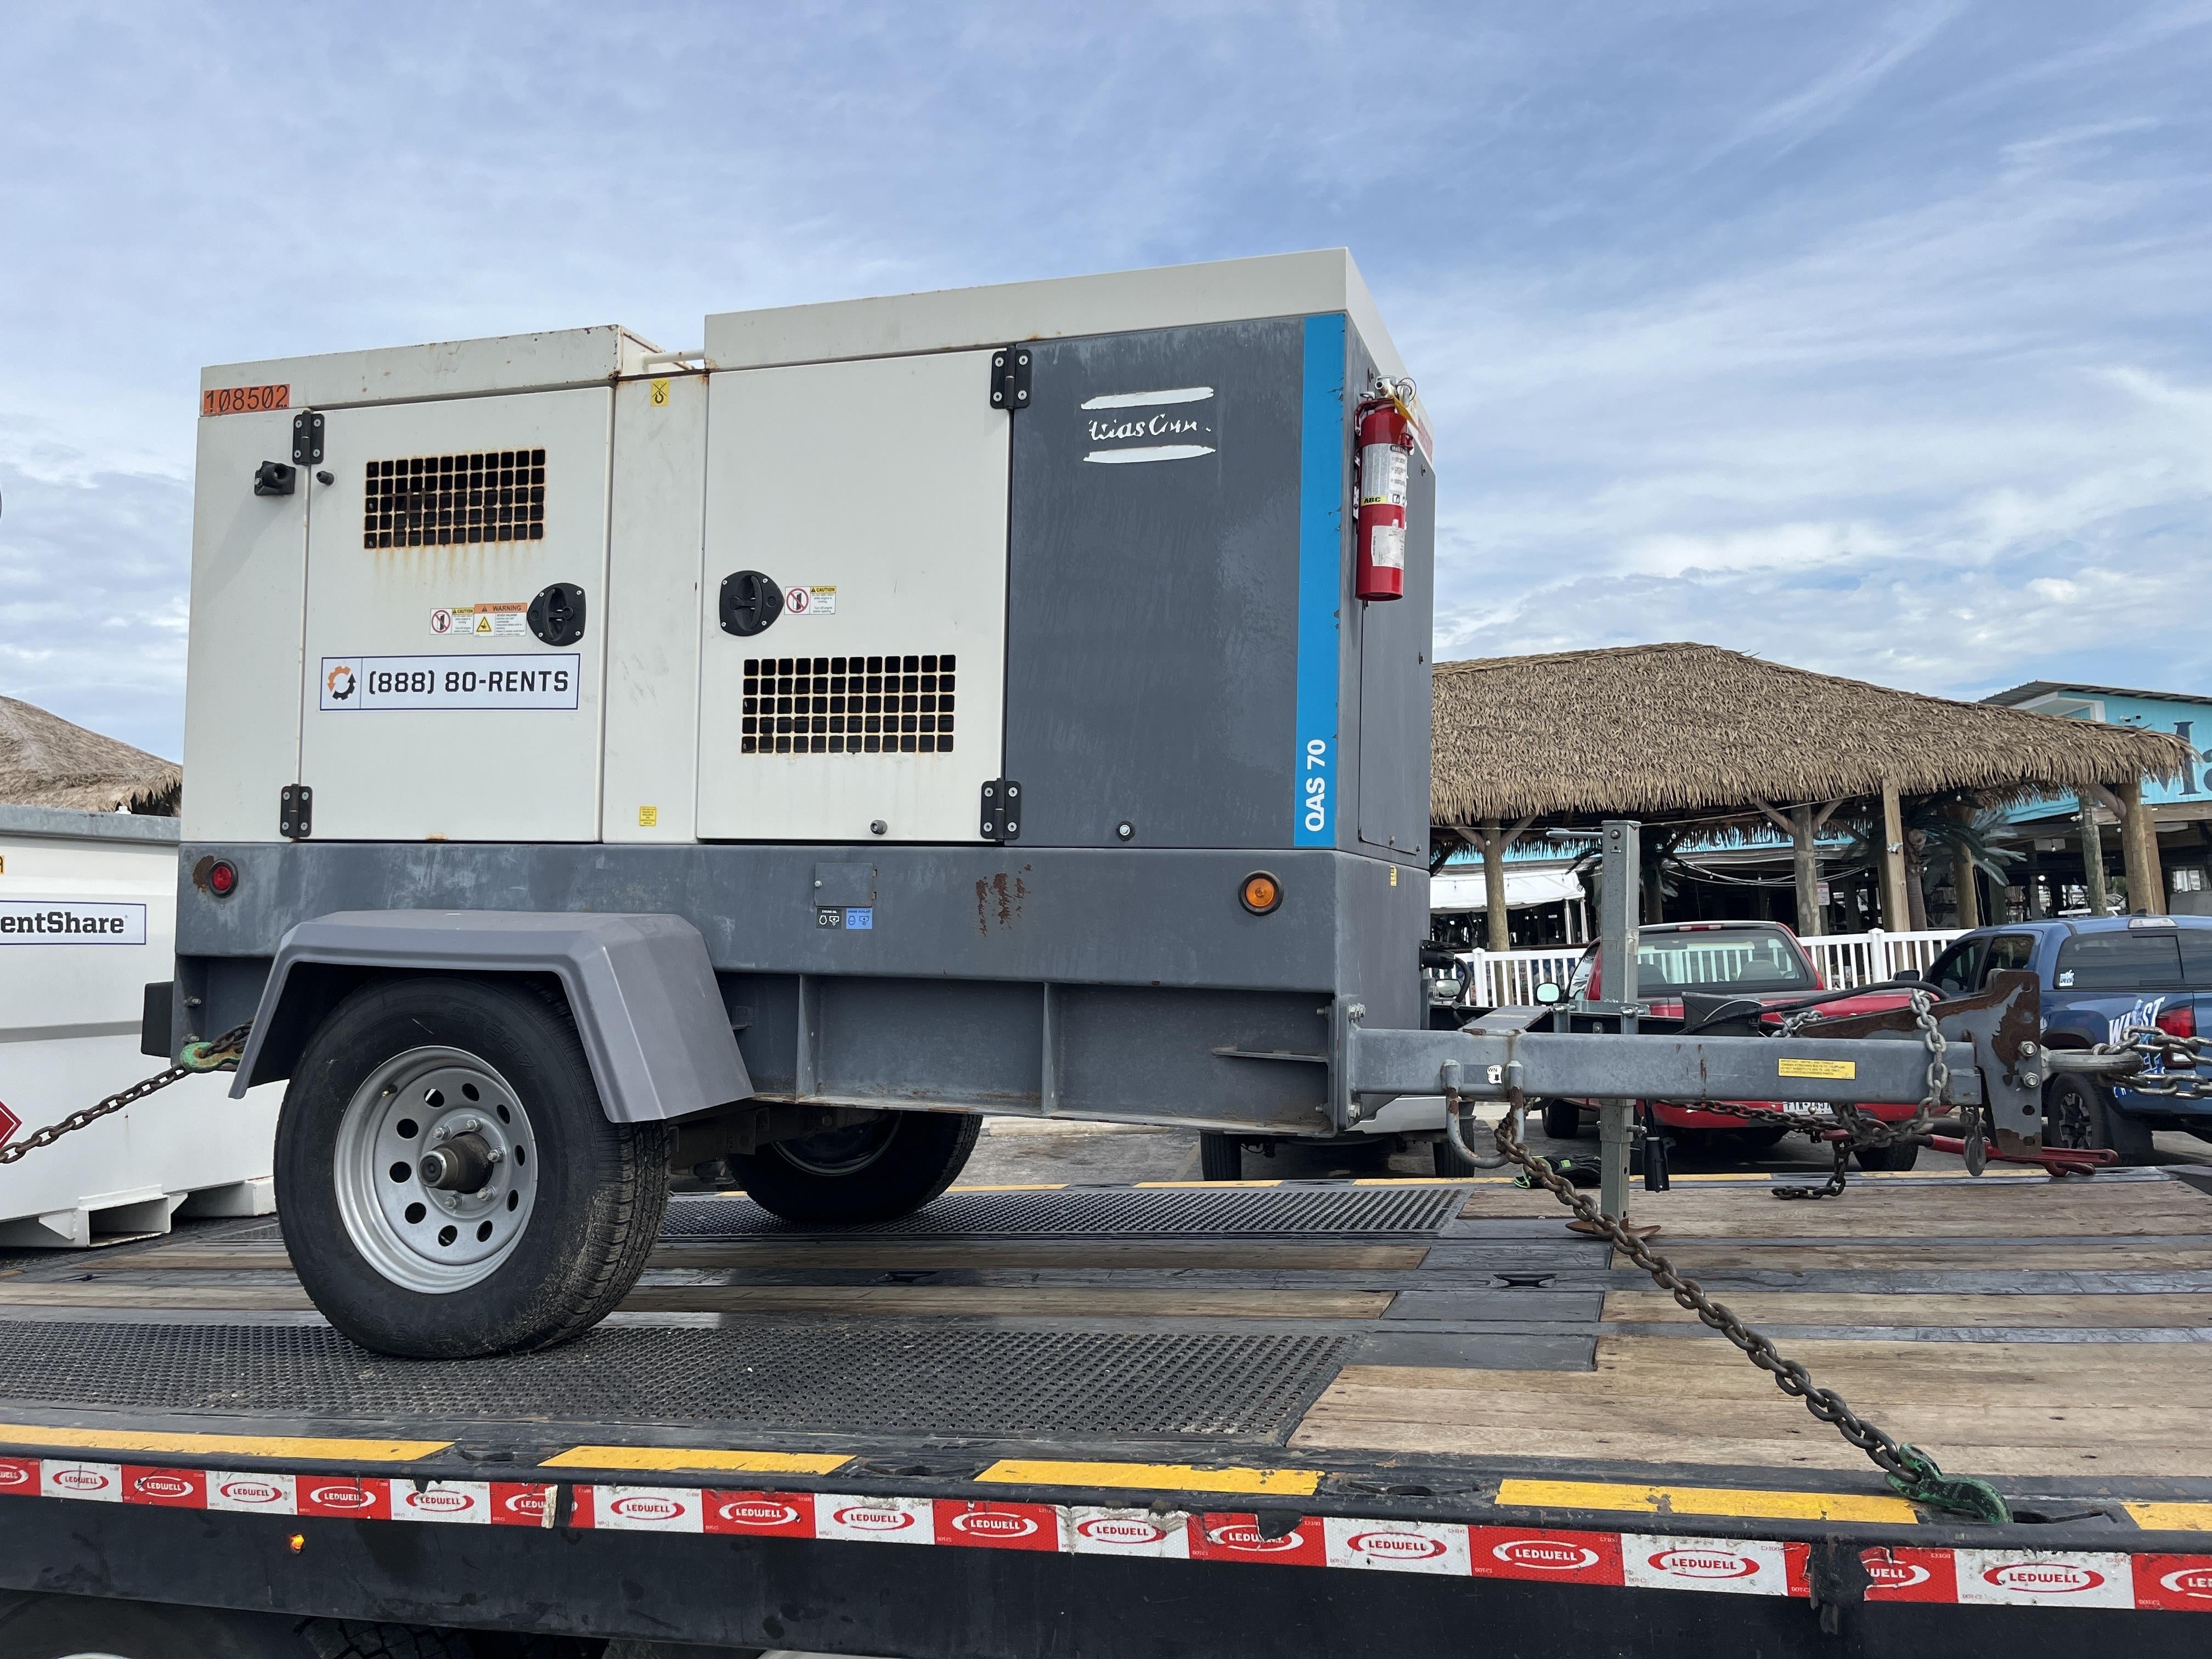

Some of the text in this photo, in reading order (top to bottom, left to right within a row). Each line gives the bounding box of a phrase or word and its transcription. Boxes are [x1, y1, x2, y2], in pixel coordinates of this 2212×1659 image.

[206, 385, 288, 413] 108502
[369, 670, 568, 695] (888) 80-RENTS
[1305, 740, 1325, 832] QAS 70
[0, 912, 124, 933] entShare
[65, 1475, 98, 1485] LEDWELL
[146, 1481, 182, 1492] LEDWELL
[233, 1487, 269, 1497] LEDWELL
[324, 1492, 362, 1502] LEDWELL
[420, 1496, 461, 1505] LEDWELL
[627, 1503, 670, 1513] LEDWELL
[736, 1508, 782, 1519] LEDWELL
[851, 1514, 899, 1523] LEDWELL
[970, 1519, 1020, 1531] LEDWELL
[1096, 1526, 1149, 1537] LEDWELL
[1368, 1540, 1426, 1551] LEDWELL
[1515, 1549, 1578, 1561] LEDWELL
[1672, 1558, 1737, 1571] LEDWELL
[1866, 1568, 1906, 1578] WELL
[2010, 1573, 2080, 1584] LEDWELL
